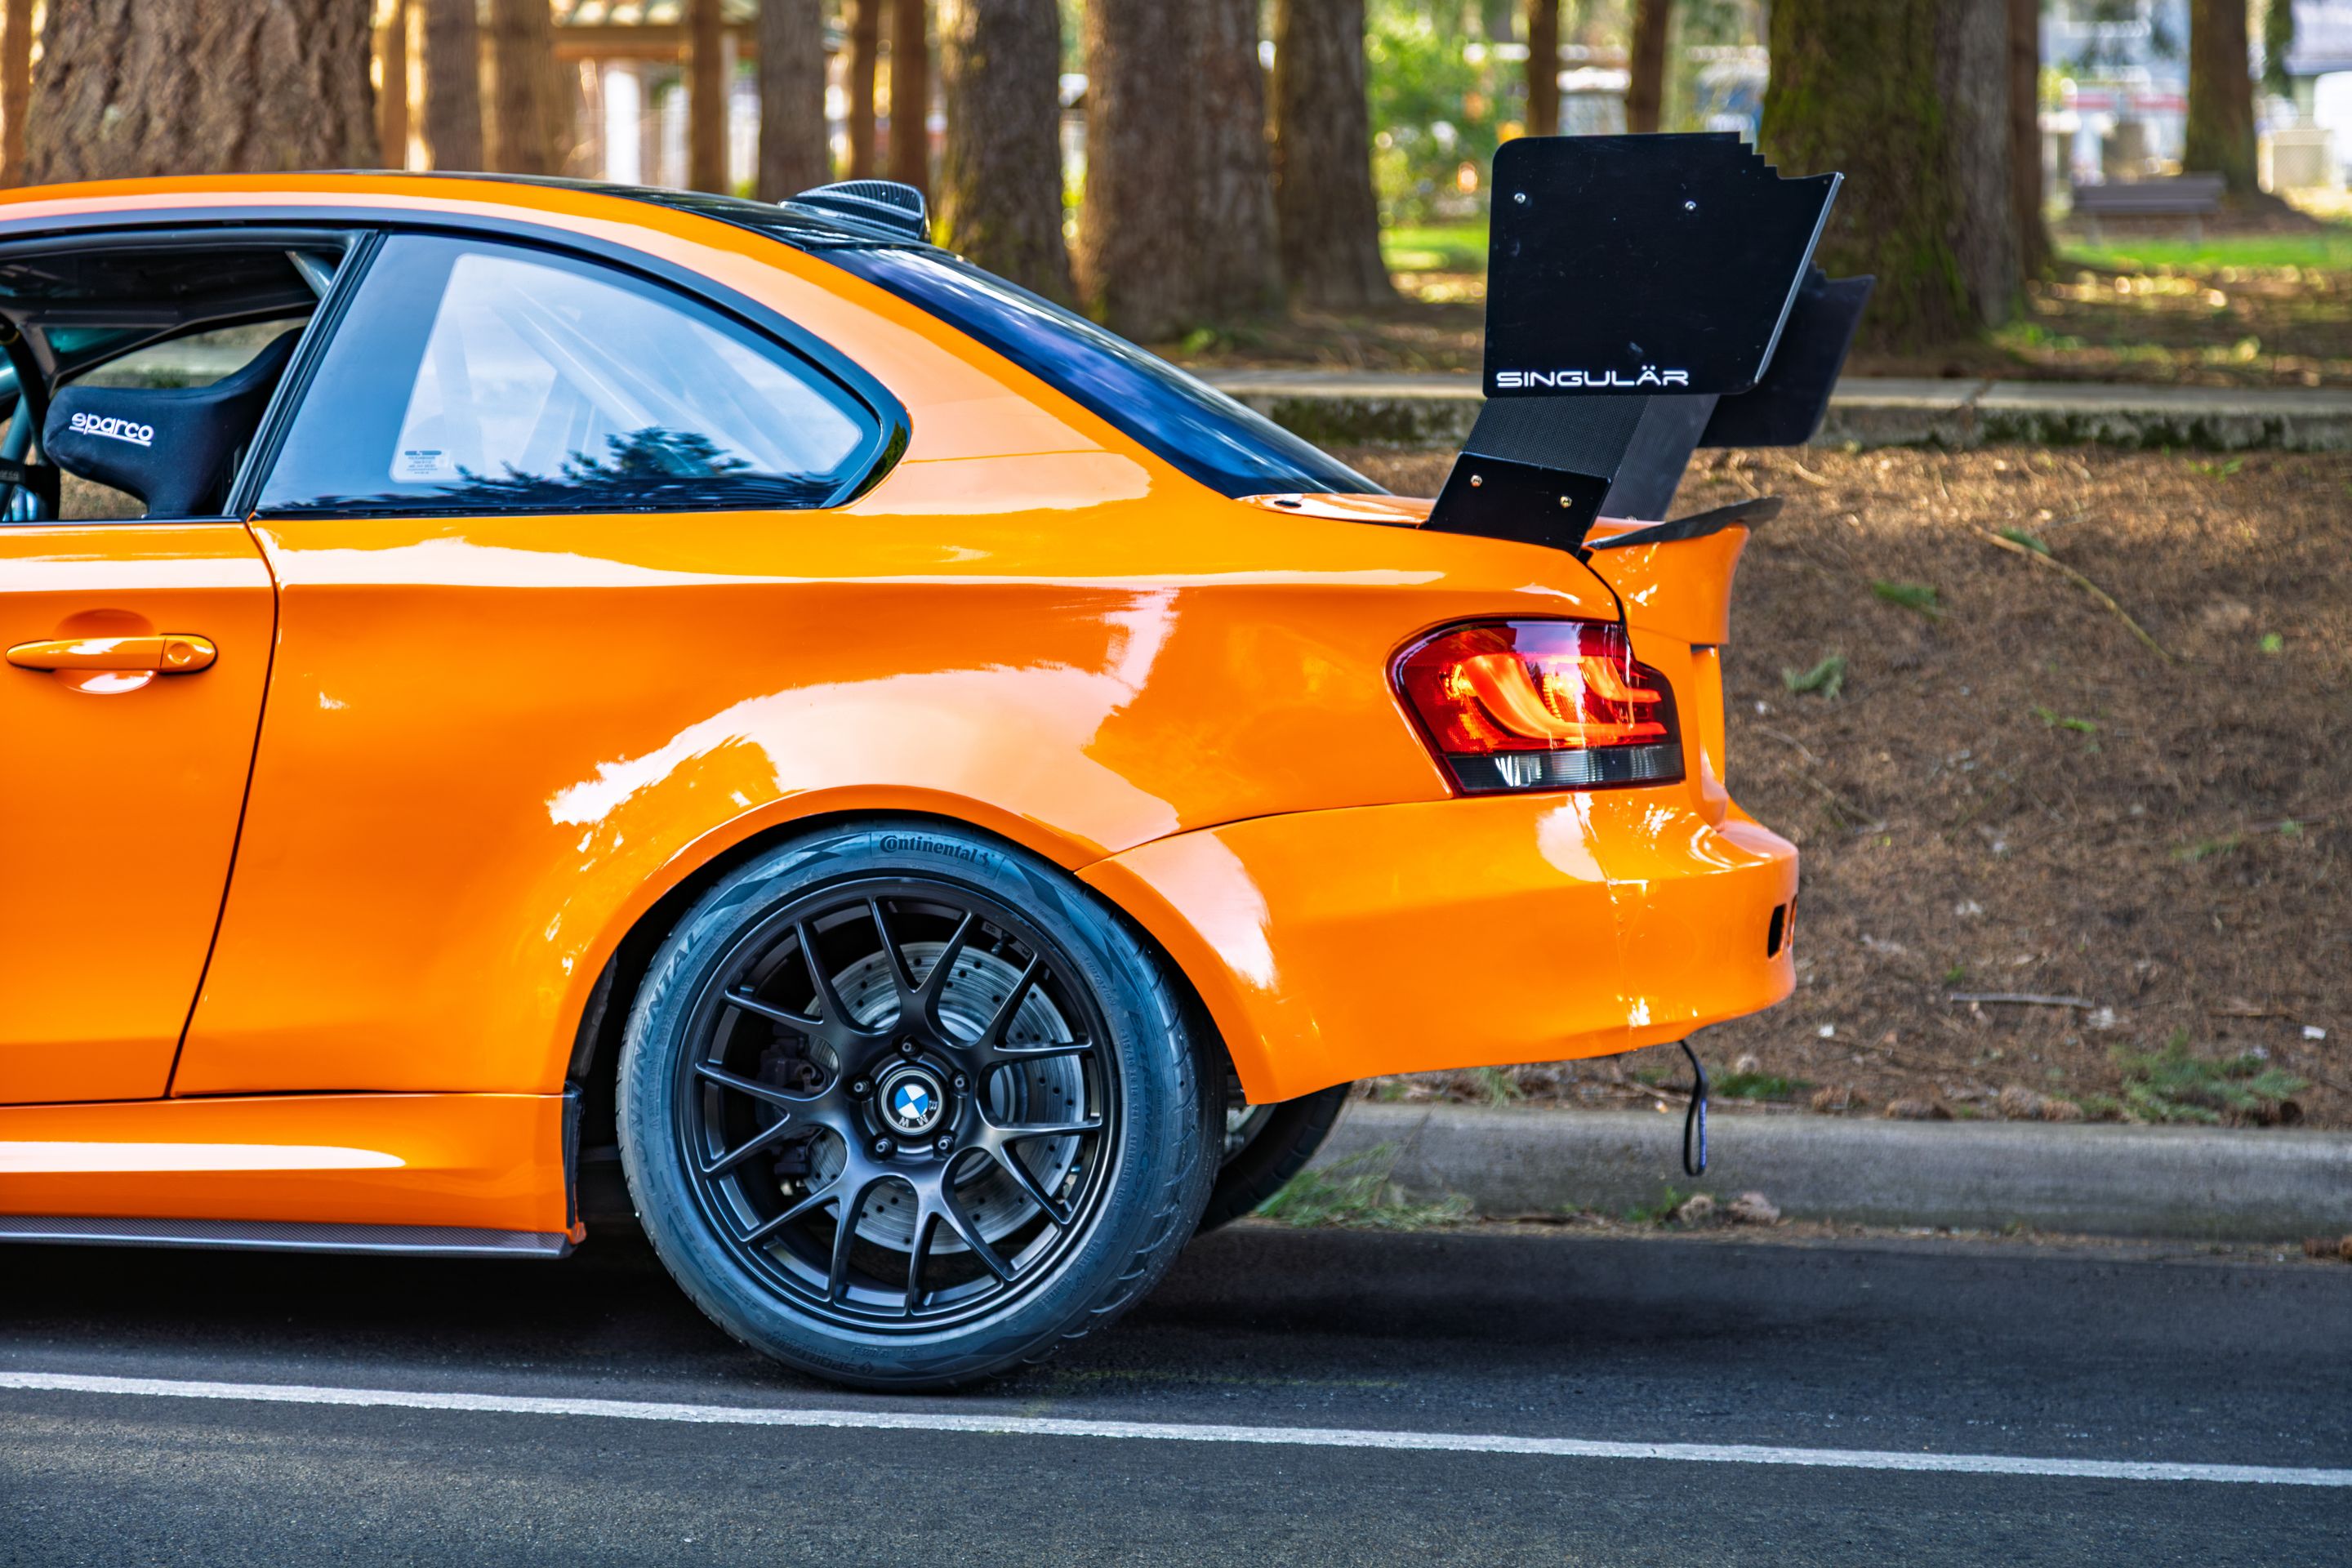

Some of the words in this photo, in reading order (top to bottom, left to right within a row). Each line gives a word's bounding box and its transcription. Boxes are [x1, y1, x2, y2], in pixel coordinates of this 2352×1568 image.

[1496, 365, 1689, 387] SINGULÄR
[70, 412, 154, 444] sparco
[880, 835, 978, 863] Continental
[898, 1100, 938, 1128] BMW
